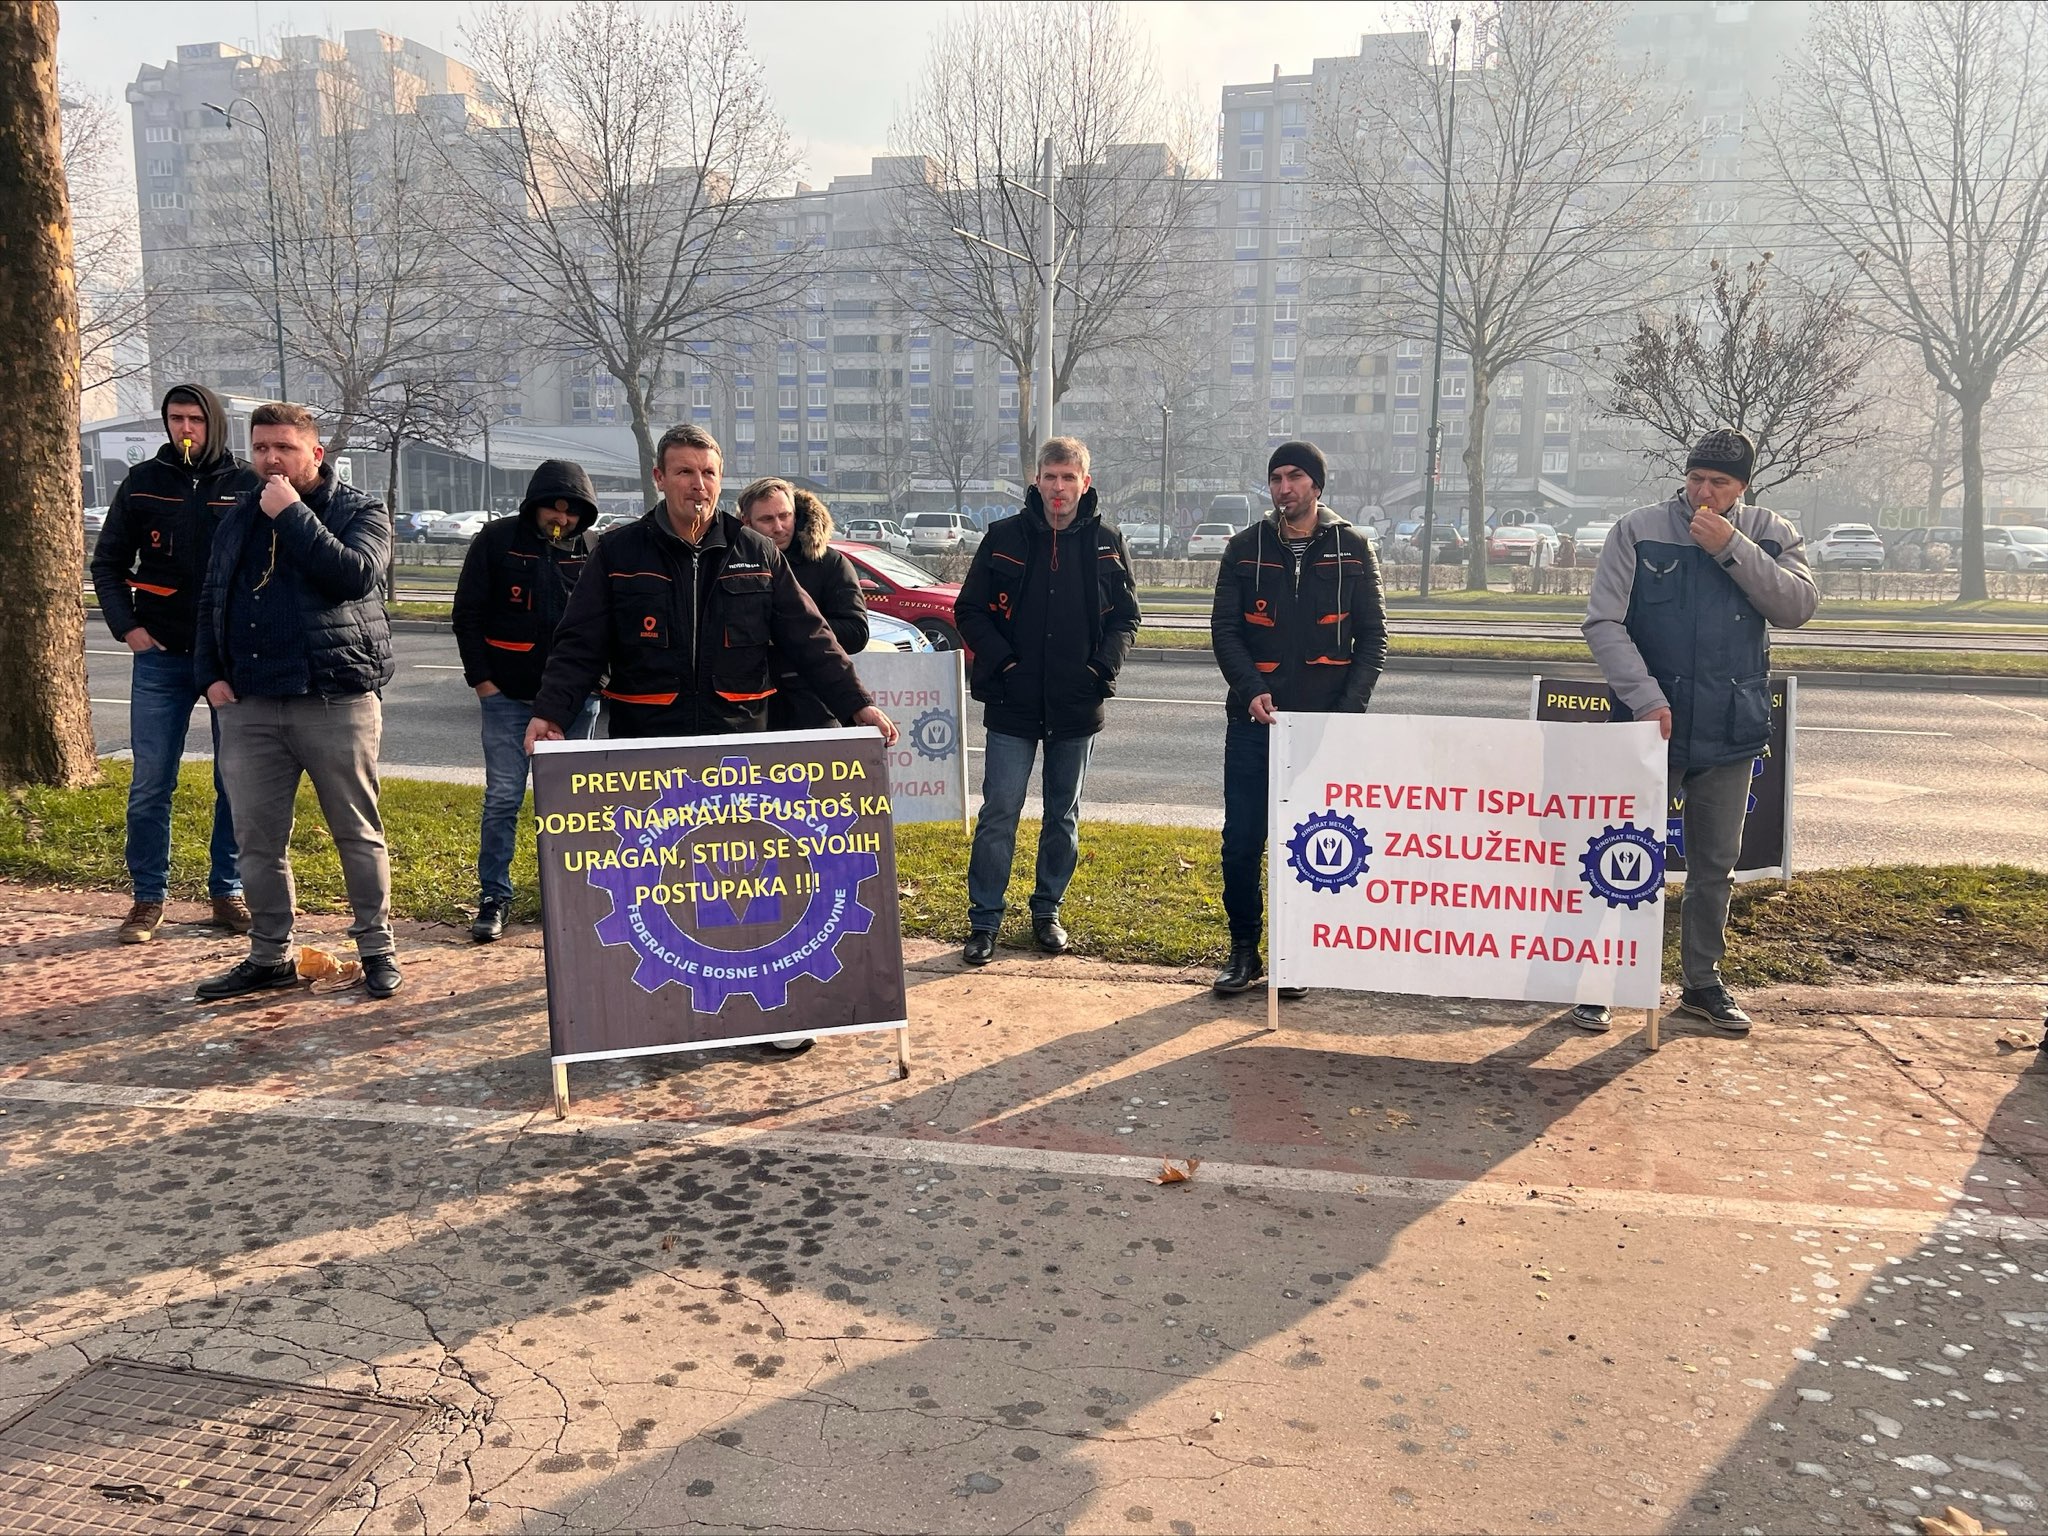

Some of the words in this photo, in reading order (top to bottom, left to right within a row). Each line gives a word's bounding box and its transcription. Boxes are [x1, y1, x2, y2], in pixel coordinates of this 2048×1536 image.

[899, 601, 932, 609] CRVENI
[571, 768, 688, 795] PREVENT
[701, 765, 762, 787] GDJE
[769, 762, 825, 784] GOD
[831, 760, 866, 781] DA
[624, 798, 752, 830] NAPRAVIŠ
[760, 792, 854, 822] PUSTOŠ
[1325, 783, 1469, 812] PREVENT
[1477, 789, 1636, 820] ISPLATITE
[1300, 820, 1328, 838] SINDIKAT
[1328, 820, 1359, 840] METALACA
[1384, 829, 1567, 867] ZASLUŽENE
[1594, 834, 1624, 852] SINDIKAT
[1626, 834, 1660, 854] METALACA
[564, 846, 687, 872] URAGAN,
[693, 840, 755, 864] STIDI
[762, 838, 791, 859] SE
[797, 832, 881, 857] SVOJIH
[635, 876, 788, 906] POSTUPAKA
[1366, 879, 1584, 914] OTPREMNINE
[627, 904, 700, 975] FEDERACIJE
[702, 965, 759, 980] BOSNE
[762, 963, 769, 976] I
[772, 888, 847, 973] HERCEGOVINE
[1312, 923, 1500, 958] RADNICIMA
[1510, 934, 1637, 967] FADA!!!
